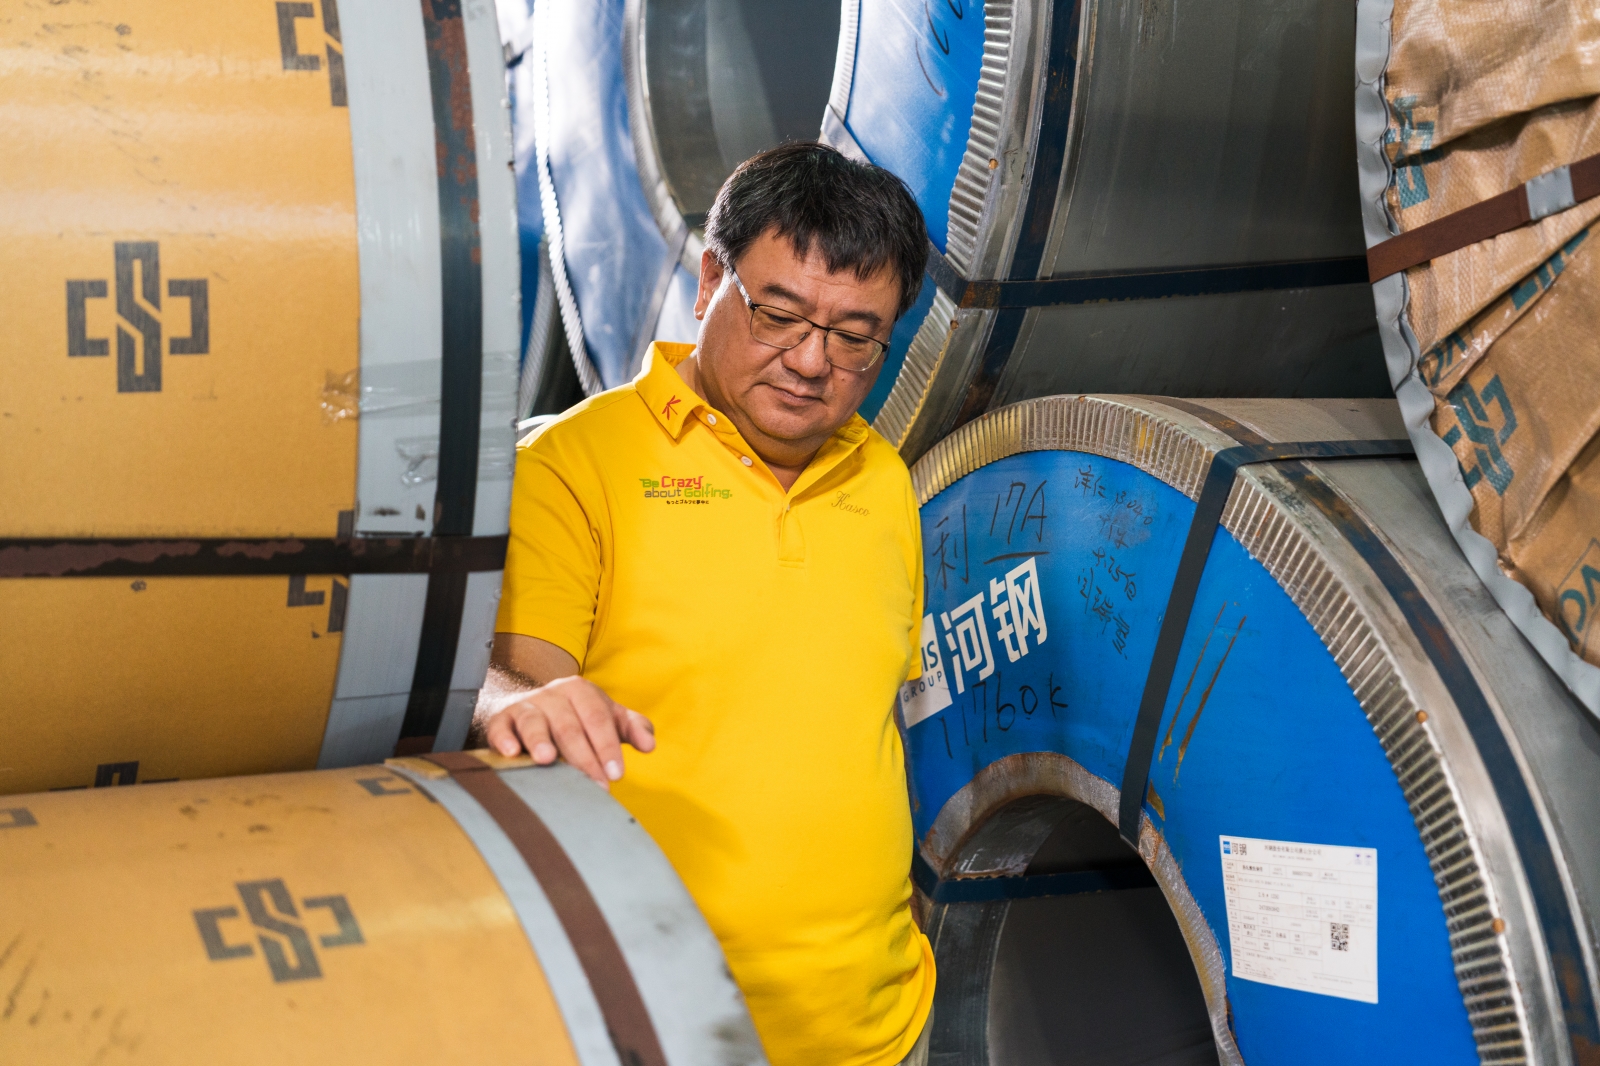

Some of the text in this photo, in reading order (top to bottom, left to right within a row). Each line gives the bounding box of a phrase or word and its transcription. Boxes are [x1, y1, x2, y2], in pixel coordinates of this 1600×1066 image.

[639, 475, 704, 490] Be Crazy
[644, 487, 682, 498] about
[940, 556, 1048, 695] 河钢
[903, 670, 944, 703] GROUP
